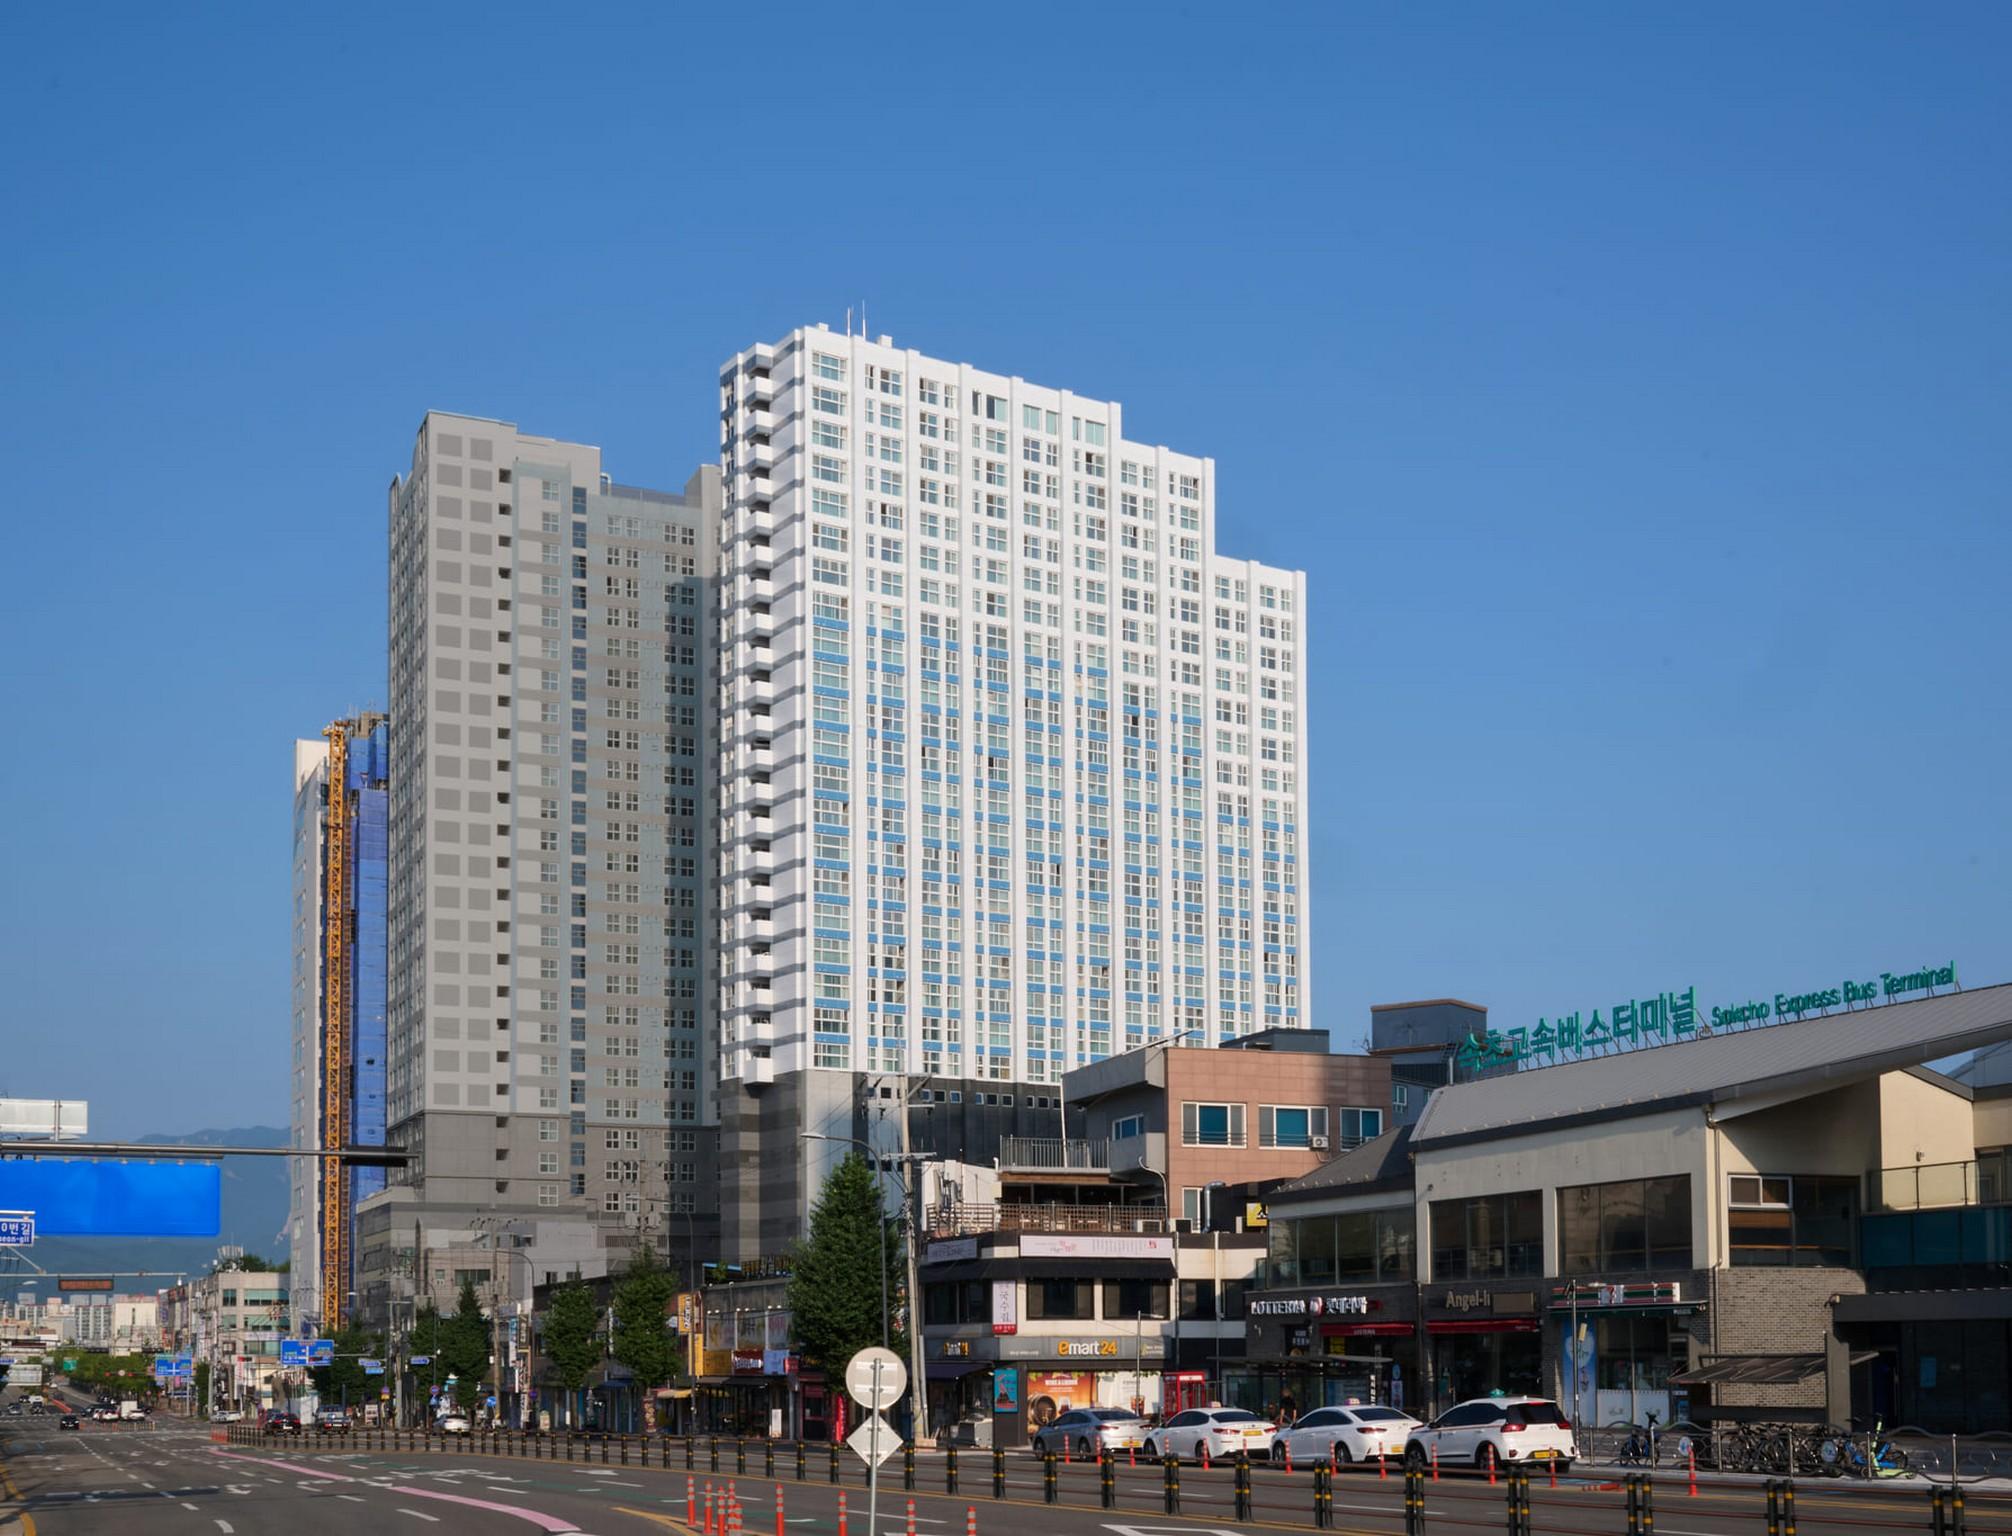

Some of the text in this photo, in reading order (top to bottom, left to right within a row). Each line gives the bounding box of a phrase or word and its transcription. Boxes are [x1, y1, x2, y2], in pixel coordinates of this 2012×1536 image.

[1712, 960, 1957, 1027] Sokcho Express Bus Terminal
[1457, 986, 1697, 1072] 속초고속버스터미널
[1251, 1301, 1305, 1315] LOTTERIA
[1058, 1339, 1118, 1357] emart24
